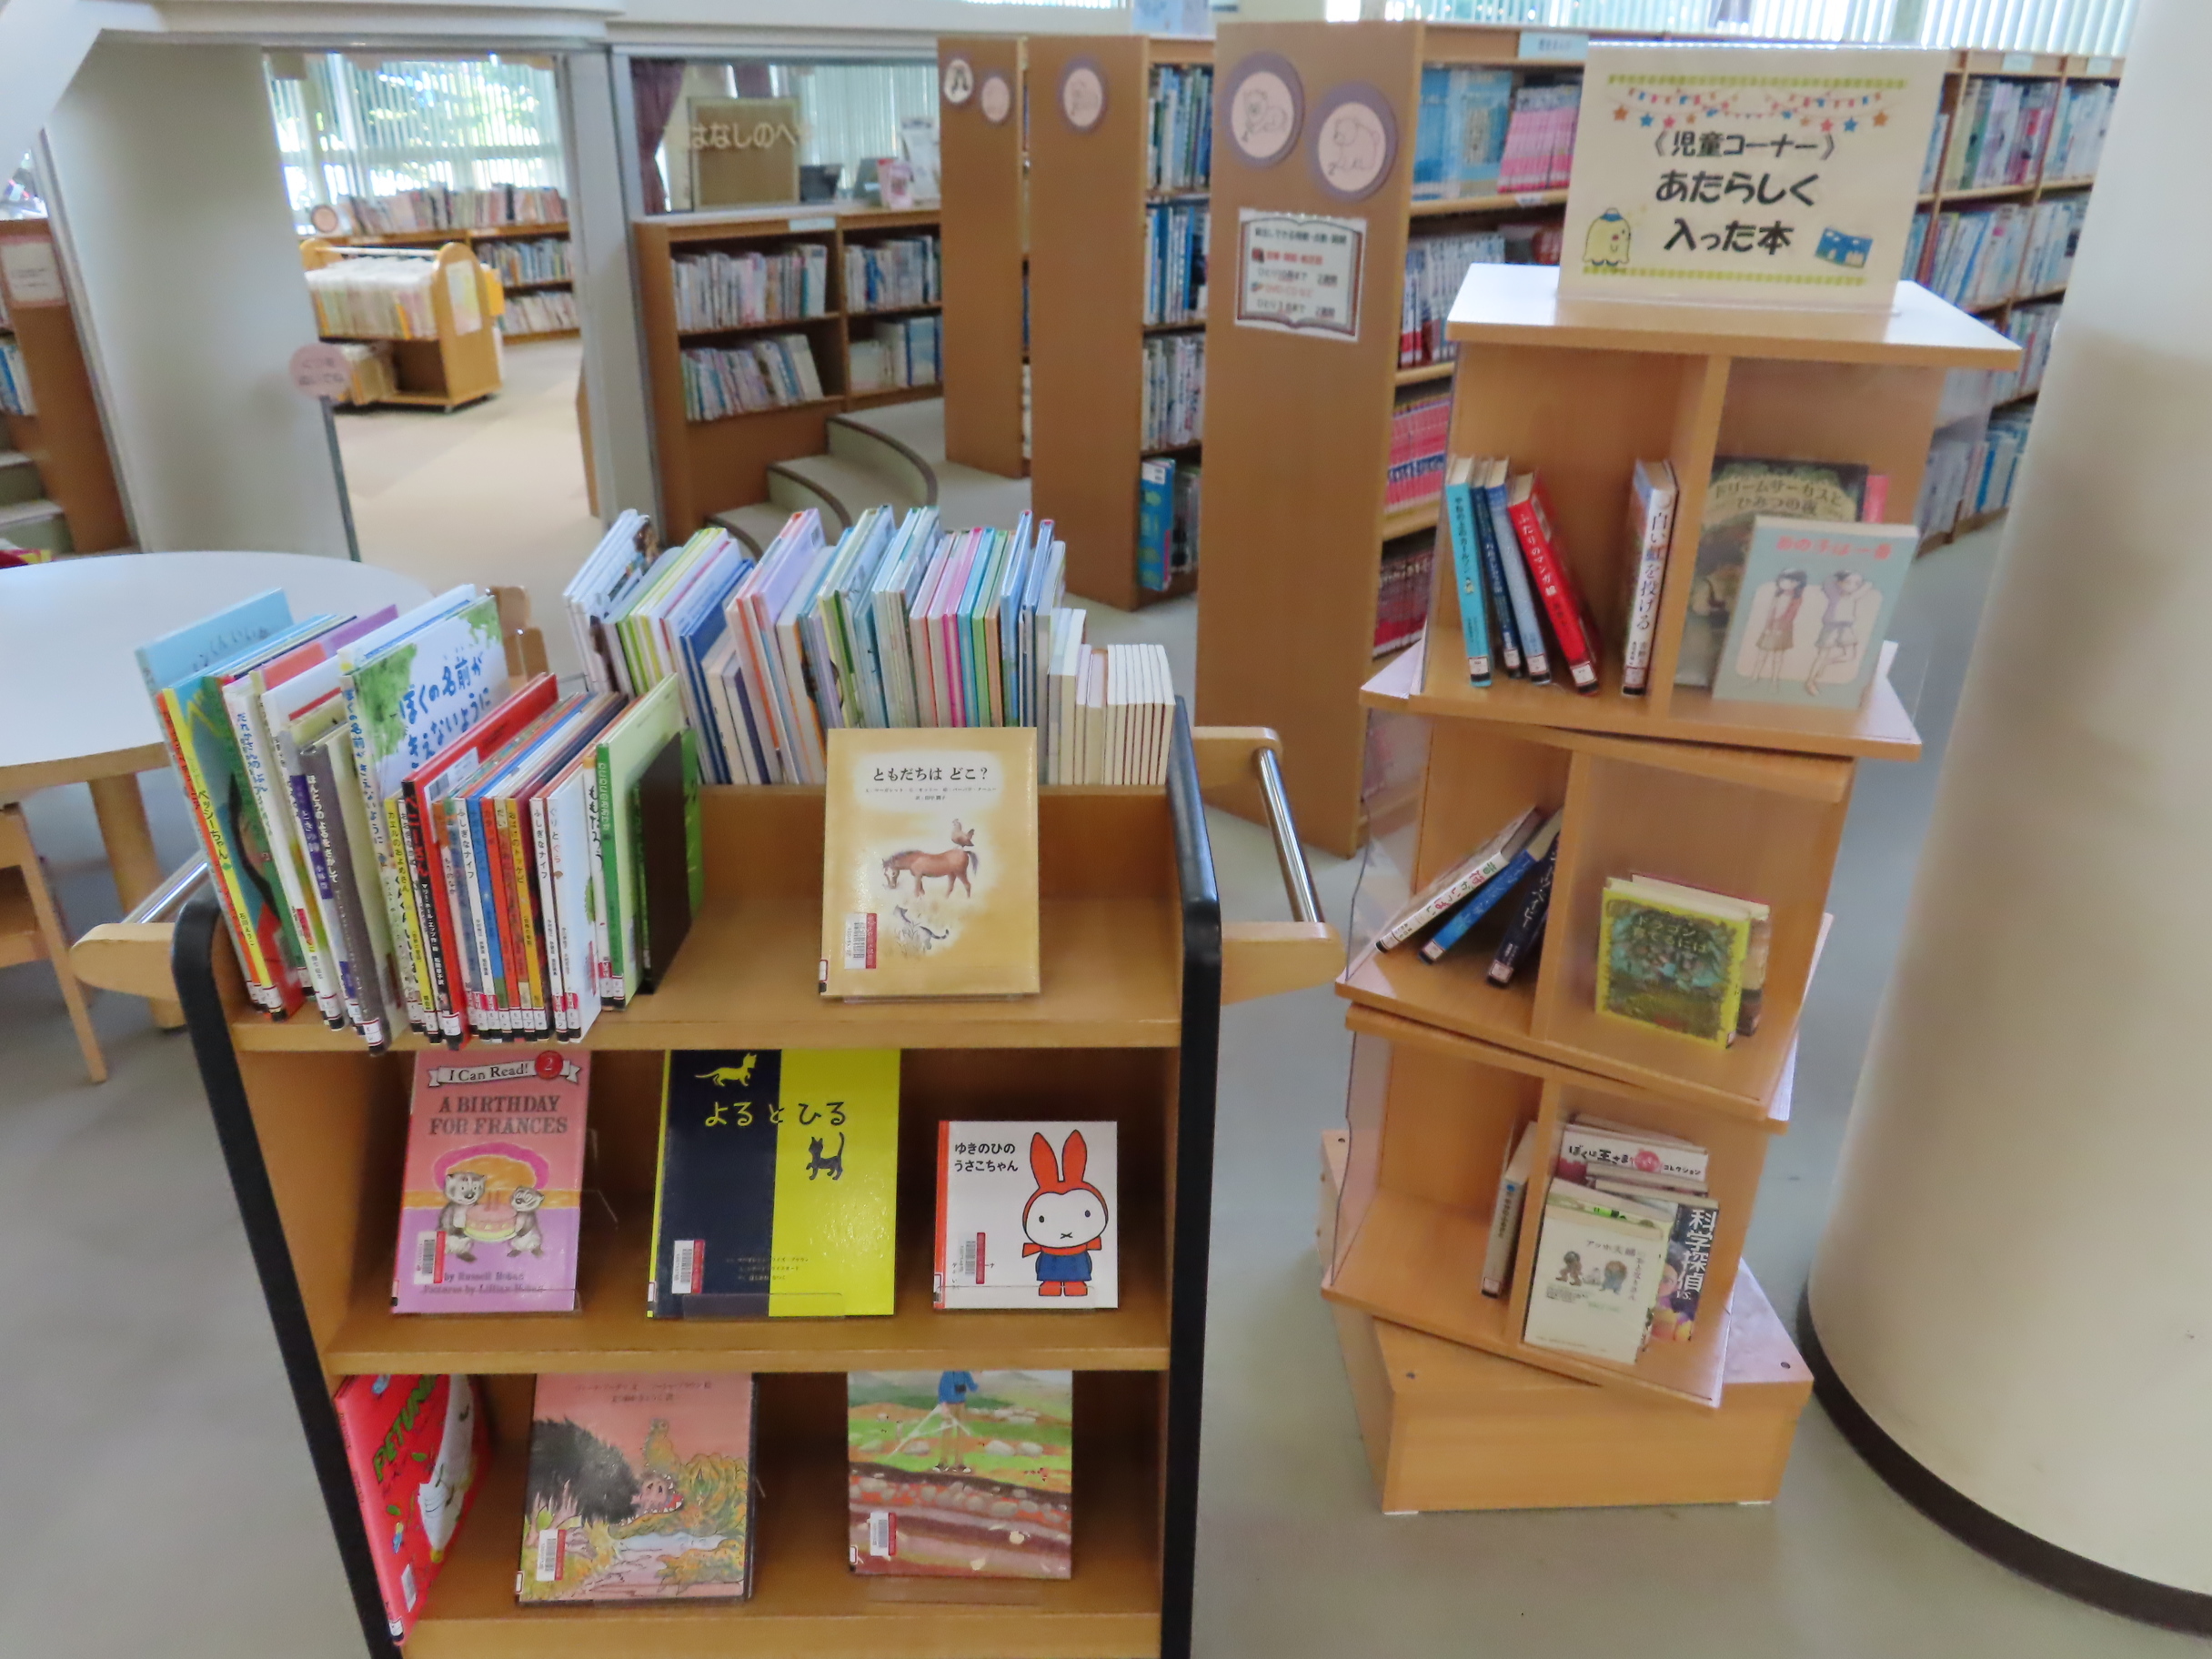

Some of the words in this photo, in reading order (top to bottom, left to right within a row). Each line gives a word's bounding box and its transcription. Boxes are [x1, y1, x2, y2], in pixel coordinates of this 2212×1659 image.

[1654, 130, 1835, 161] 《児童コーナー》
[1654, 170, 1820, 206] あたらしく
[1664, 217, 1795, 256] 入った本
[873, 767, 942, 782] ともだちは
[950, 766, 988, 780] どこ？
[457, 809, 475, 879] ふしぎなナイフ
[533, 809, 548, 879] ふしぎなナイフ
[549, 808, 561, 863] ぐりとぐら
[448, 1069, 455, 1081] I
[458, 1069, 486, 1081] Can
[489, 1063, 528, 1079] Read!
[545, 1057, 553, 1071] 2
[438, 1096, 451, 1112] A
[457, 1095, 561, 1113] BIRTHDAY
[429, 1118, 468, 1135] FOR
[474, 1116, 568, 1135] FRANCES
[954, 1142, 1015, 1155] ゆきのひの
[1568, 1144, 1630, 1165] ぼくは王さま
[1664, 1164, 1702, 1176] コレクション
[954, 1160, 1019, 1172] うさこちゃん
[1677, 1209, 1717, 1292] 科学探偵
